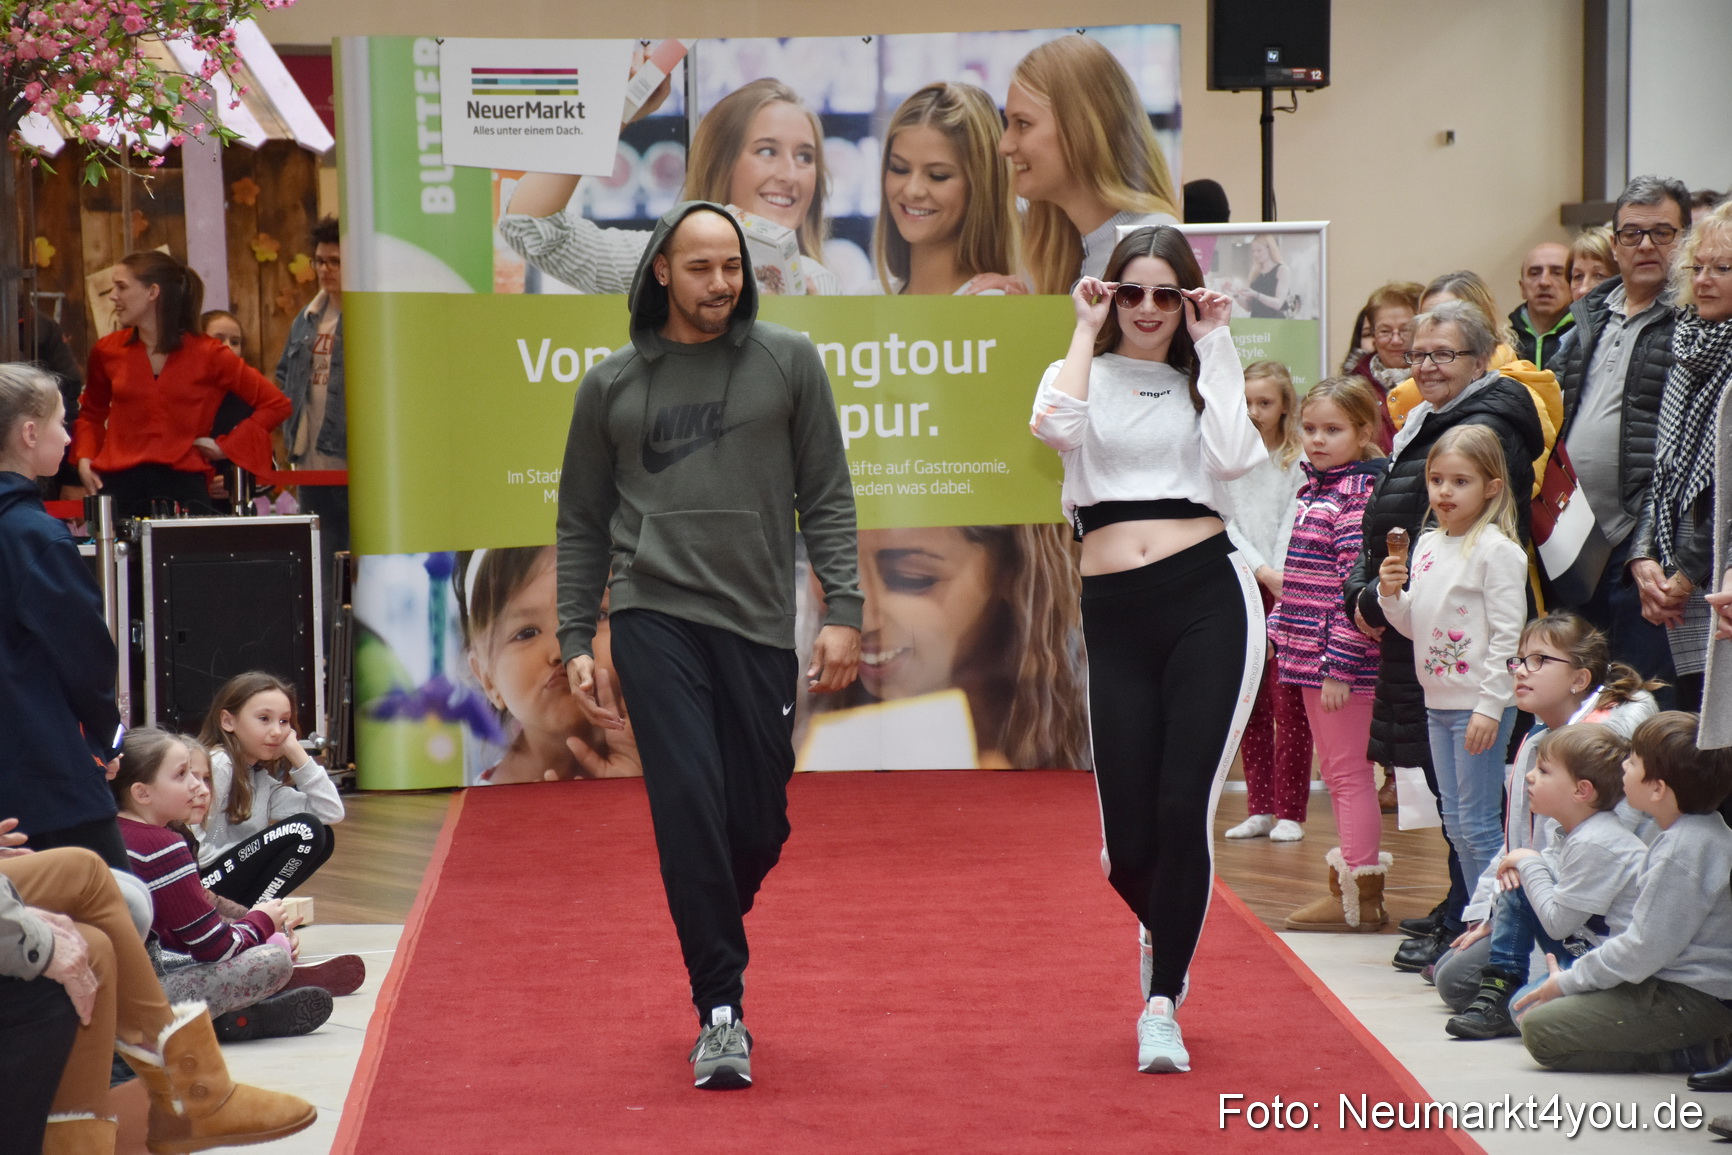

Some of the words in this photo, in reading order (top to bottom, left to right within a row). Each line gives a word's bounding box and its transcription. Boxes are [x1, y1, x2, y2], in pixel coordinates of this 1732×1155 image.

[1311, 70, 1322, 80] 12
[467, 101, 586, 119] NeuerMarkt
[473, 126, 495, 135] Alles
[497, 127, 521, 135] unter
[524, 127, 554, 135] einem
[556, 126, 583, 135] Dach.
[1231, 332, 1271, 346] ngsteil
[803, 331, 997, 388] ngtour
[652, 401, 727, 442] NIKE
[840, 402, 939, 449] pur.
[885, 459, 910, 475] auf
[914, 459, 1011, 475] Gastronomie,
[507, 470, 525, 484] Im
[527, 468, 562, 484] Stad
[897, 483, 927, 495] was
[930, 479, 974, 495] dabei.
[237, 838, 261, 862] SAN
[263, 822, 314, 846] FRANCISCO
[296, 844, 312, 855] 58
[279, 858, 303, 879] SAN
